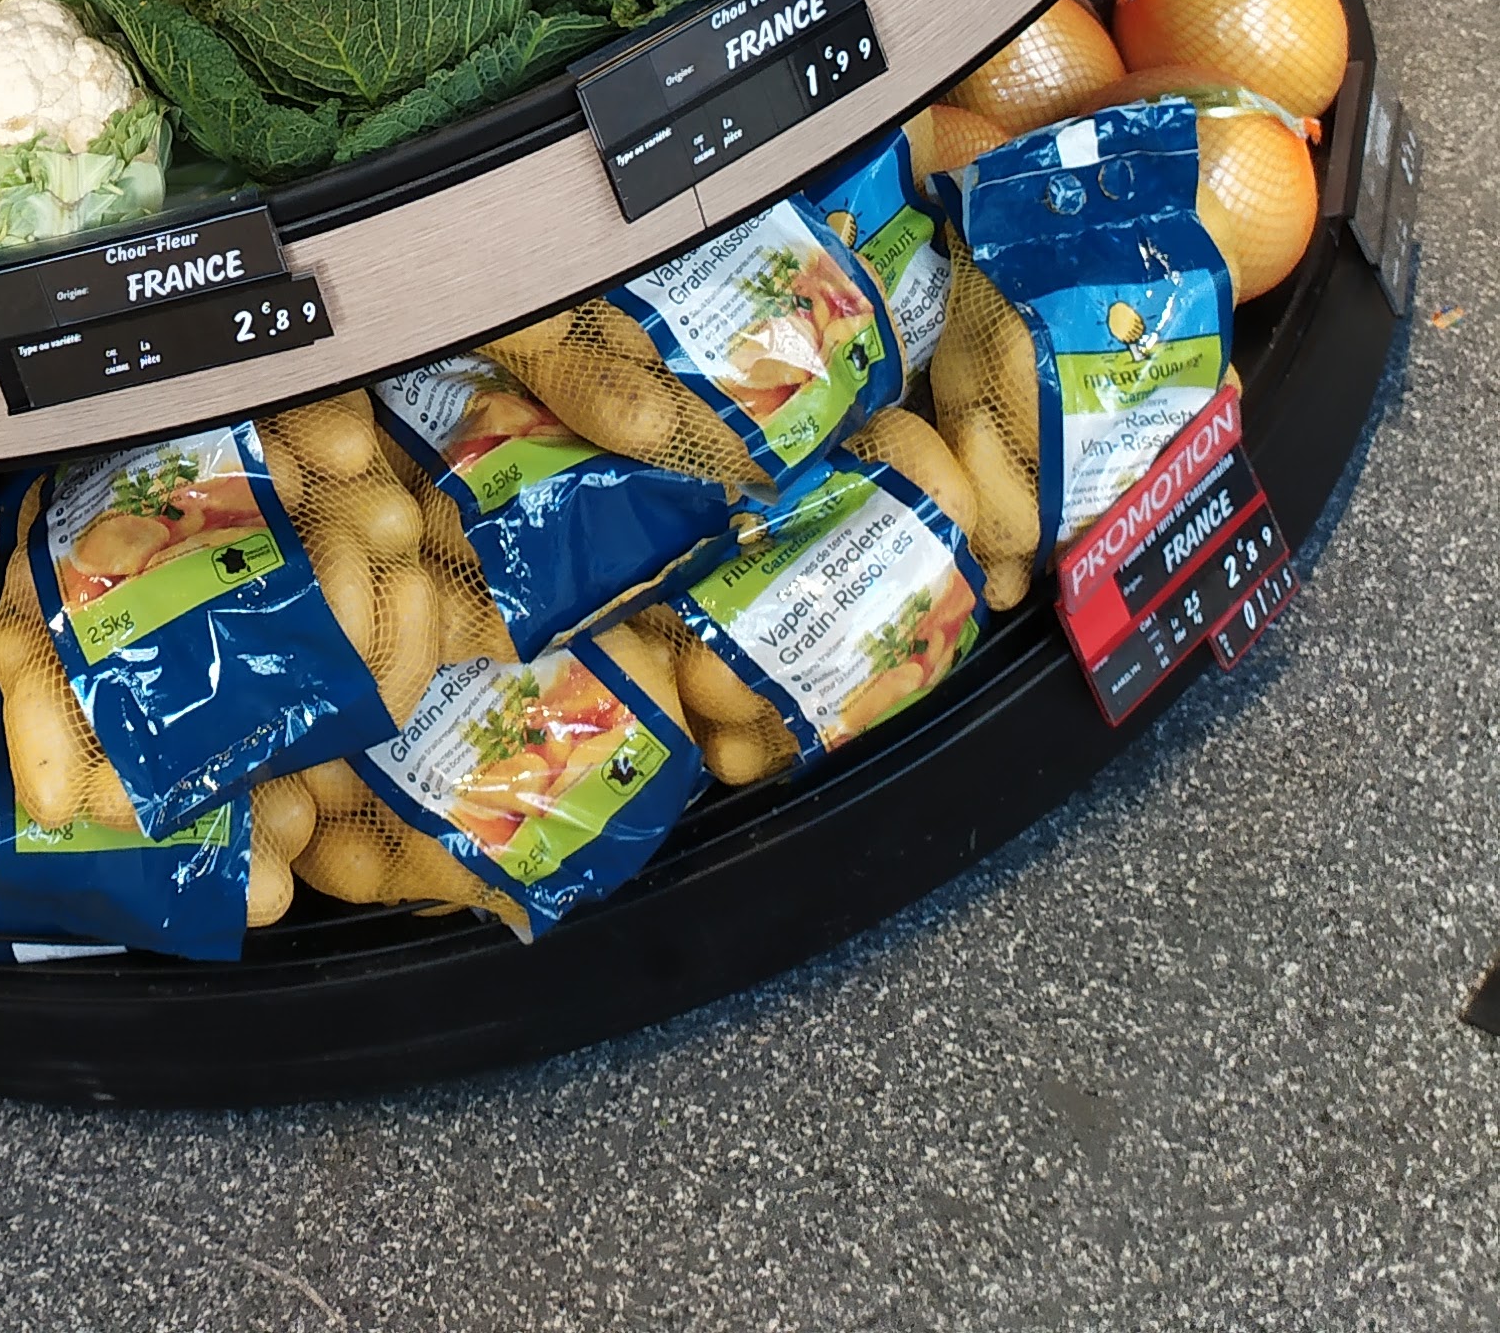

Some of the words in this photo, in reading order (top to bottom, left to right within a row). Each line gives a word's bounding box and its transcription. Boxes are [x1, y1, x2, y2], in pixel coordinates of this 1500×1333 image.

[710, 0, 748, 30] Chou
[105, 231, 199, 266] Chou-Fleur
[126, 249, 245, 303] FRANCE
[17, 342, 39, 359] Type
[139, 352, 162, 370] pièce
[482, 462, 524, 501] 2,5kg
[1071, 402, 1235, 597] PROMOTION
[1162, 487, 1235, 575] FRANCE
[86, 608, 136, 645] 2,5kg
[389, 655, 490, 763] Gratin-Risso
